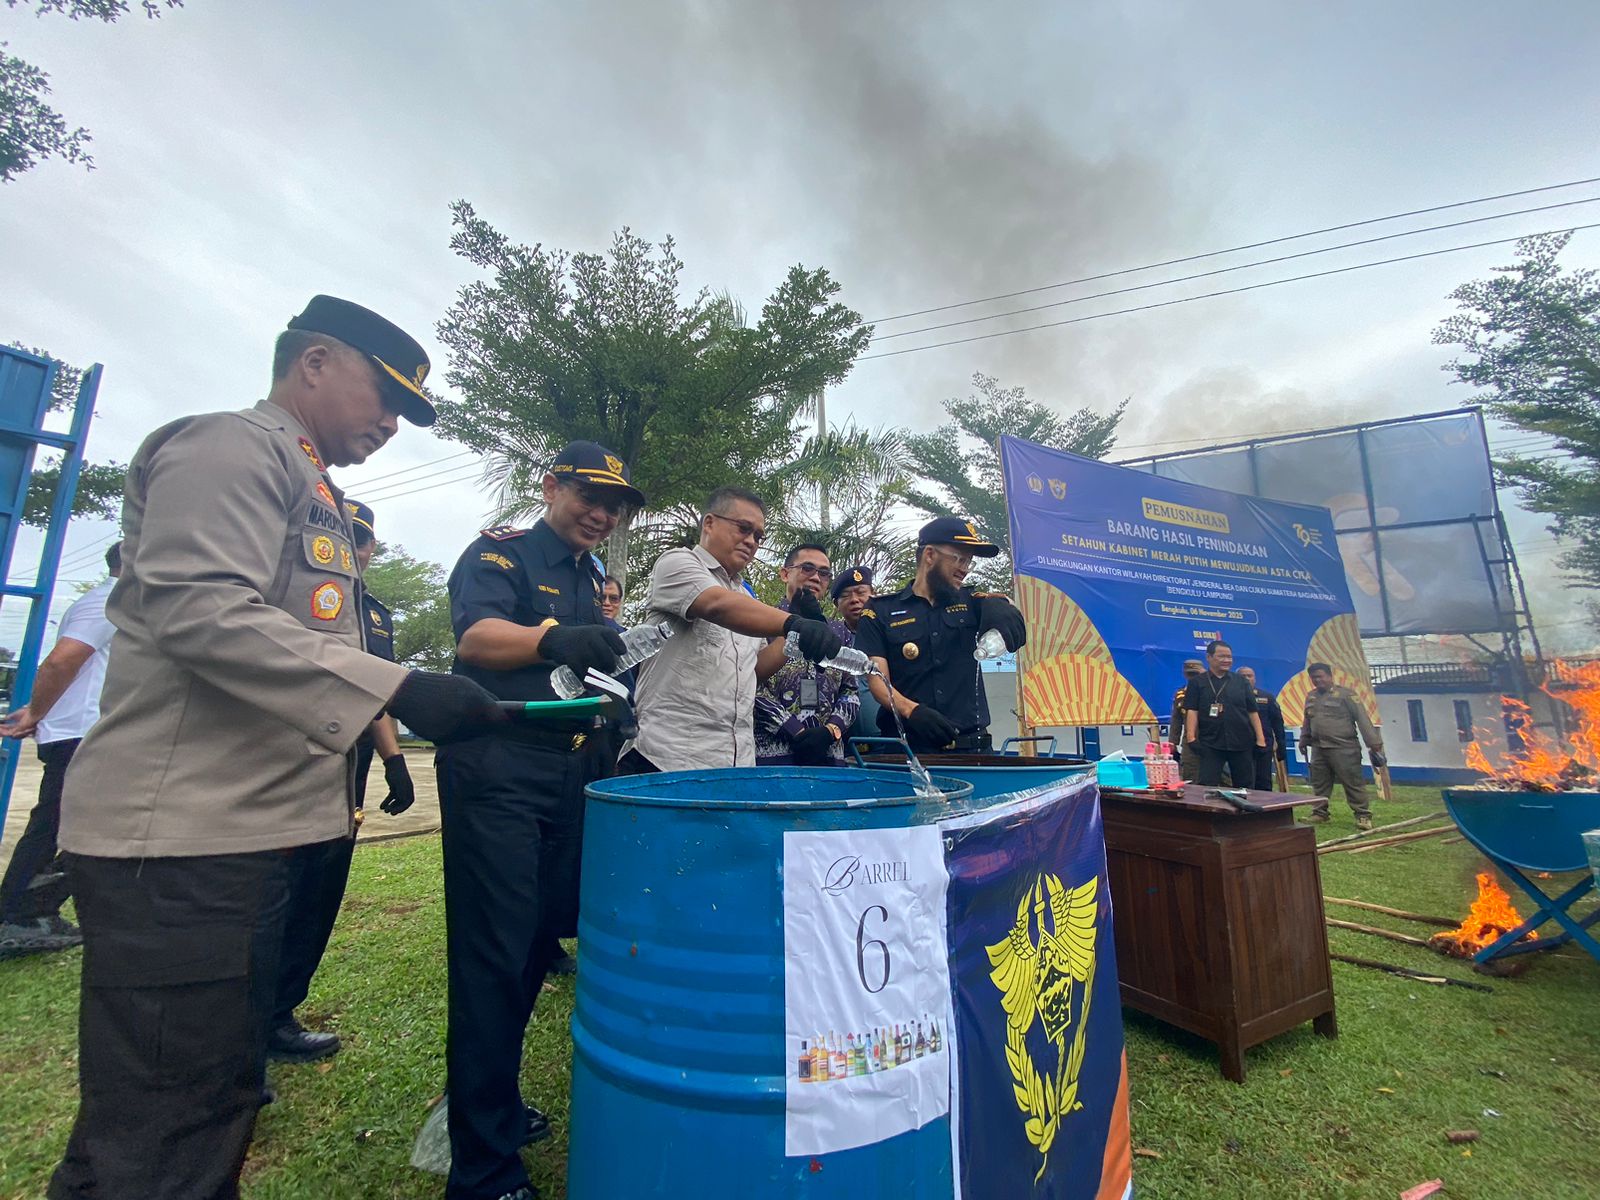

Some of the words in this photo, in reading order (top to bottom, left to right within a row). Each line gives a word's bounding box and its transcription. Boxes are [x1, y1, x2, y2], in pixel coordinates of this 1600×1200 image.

[1144, 501, 1227, 529] PEMUSNAHAN
[1061, 534, 1106, 552] SETAHUN
[1109, 540, 1148, 559] KABINET
[1151, 548, 1181, 564] MERAH
[1183, 554, 1208, 568] PUTIH
[1210, 559, 1268, 576] MEWUJUDKAN
[1270, 568, 1291, 578] ASTA
[1107, 519, 1160, 541] BARANG
[1162, 529, 1195, 548] HASIL
[1197, 535, 1268, 559] PENINDAKAN
[1037, 555, 1046, 564] DI
[1045, 556, 1094, 573] LINGKUNGAN
[1093, 565, 1123, 577] KANTOR
[1122, 569, 1153, 581] WILAYAH
[1152, 574, 1191, 586] DIREKTORAT
[1191, 578, 1223, 590] JENDERAL
[1161, 604, 1189, 615] Bengkulu,
[1190, 607, 1199, 616] 06
[1199, 609, 1227, 618] November
[1228, 611, 1243, 619] 2025
[821, 855, 912, 897] BARREL
[856, 905, 891, 994] 6
